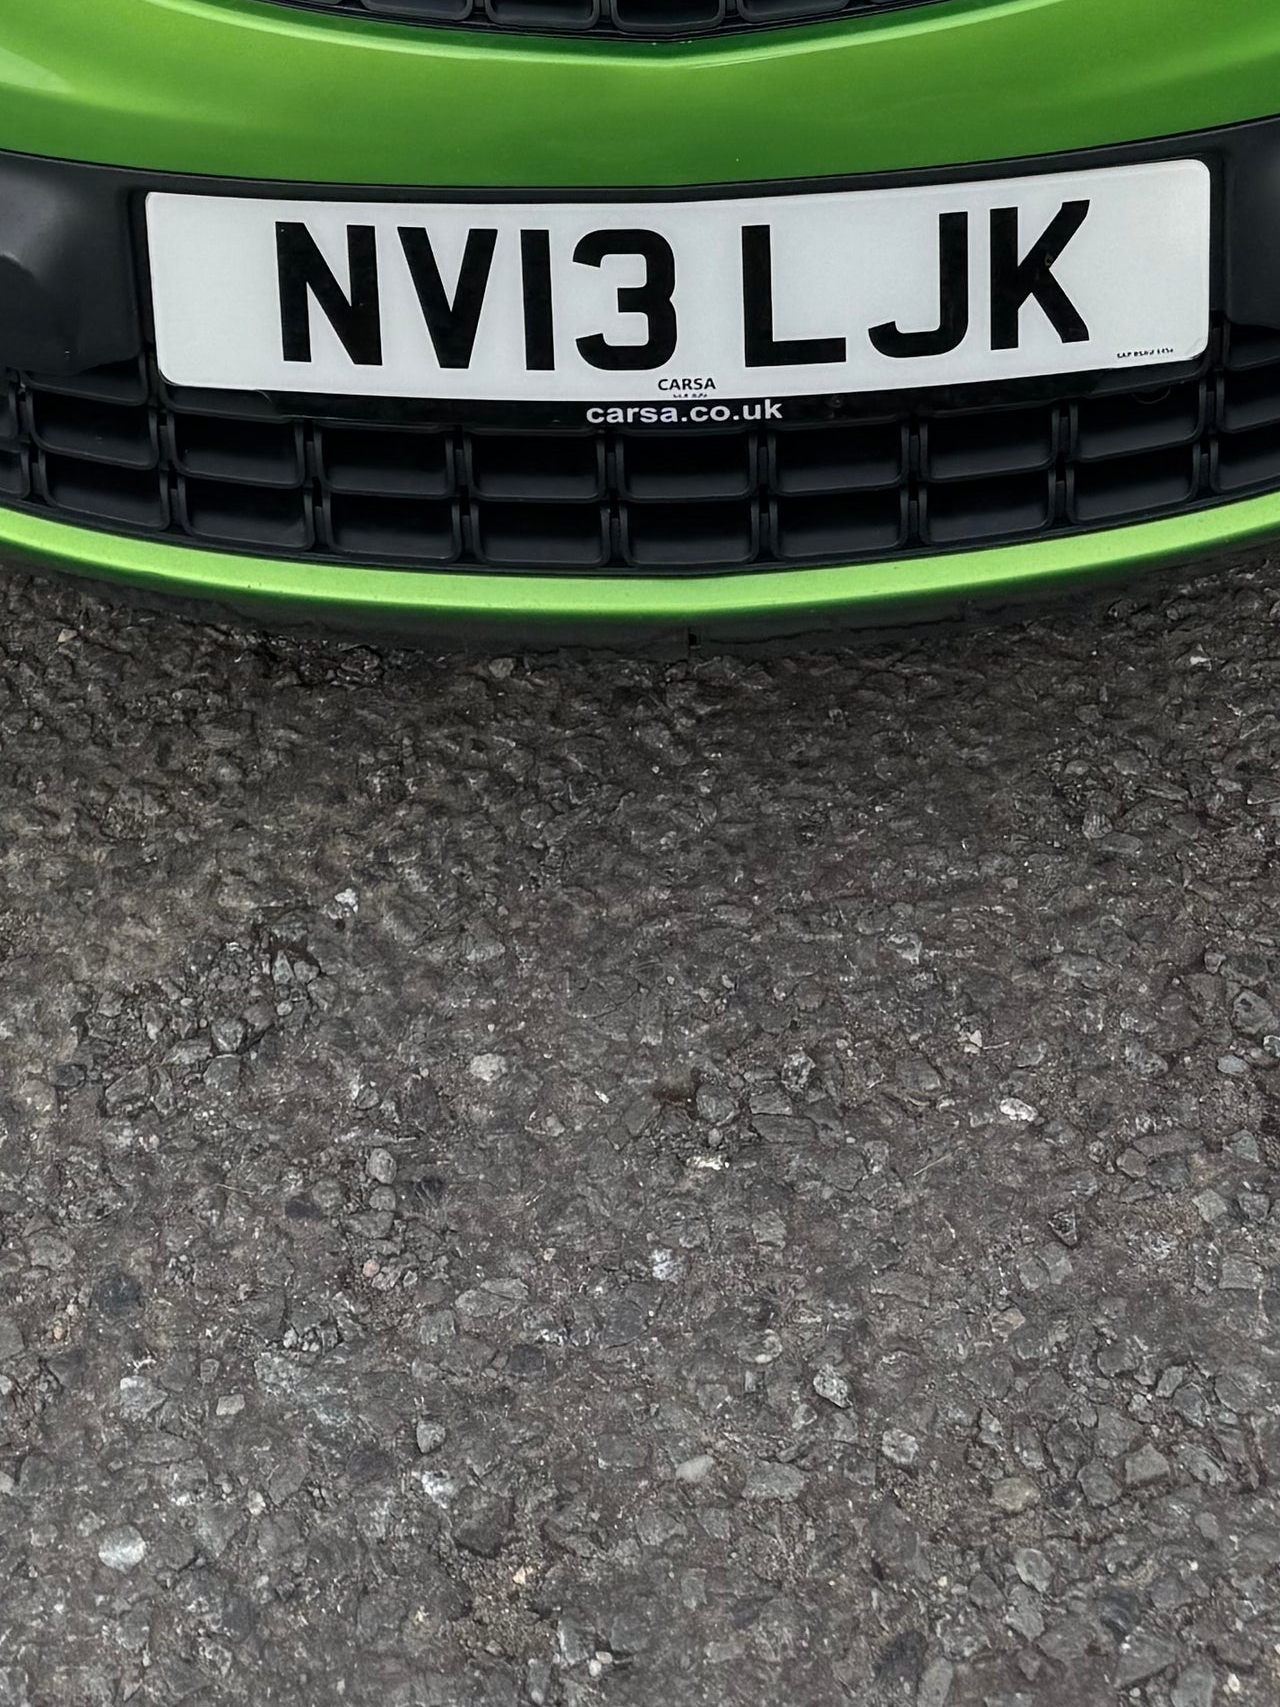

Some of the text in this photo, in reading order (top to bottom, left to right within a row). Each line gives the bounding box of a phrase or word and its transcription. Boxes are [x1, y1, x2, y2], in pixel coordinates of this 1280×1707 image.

[275, 200, 1091, 371] NV13 LJK
[657, 377, 716, 391] CARSA
[586, 399, 783, 423] carsa.co.uk
